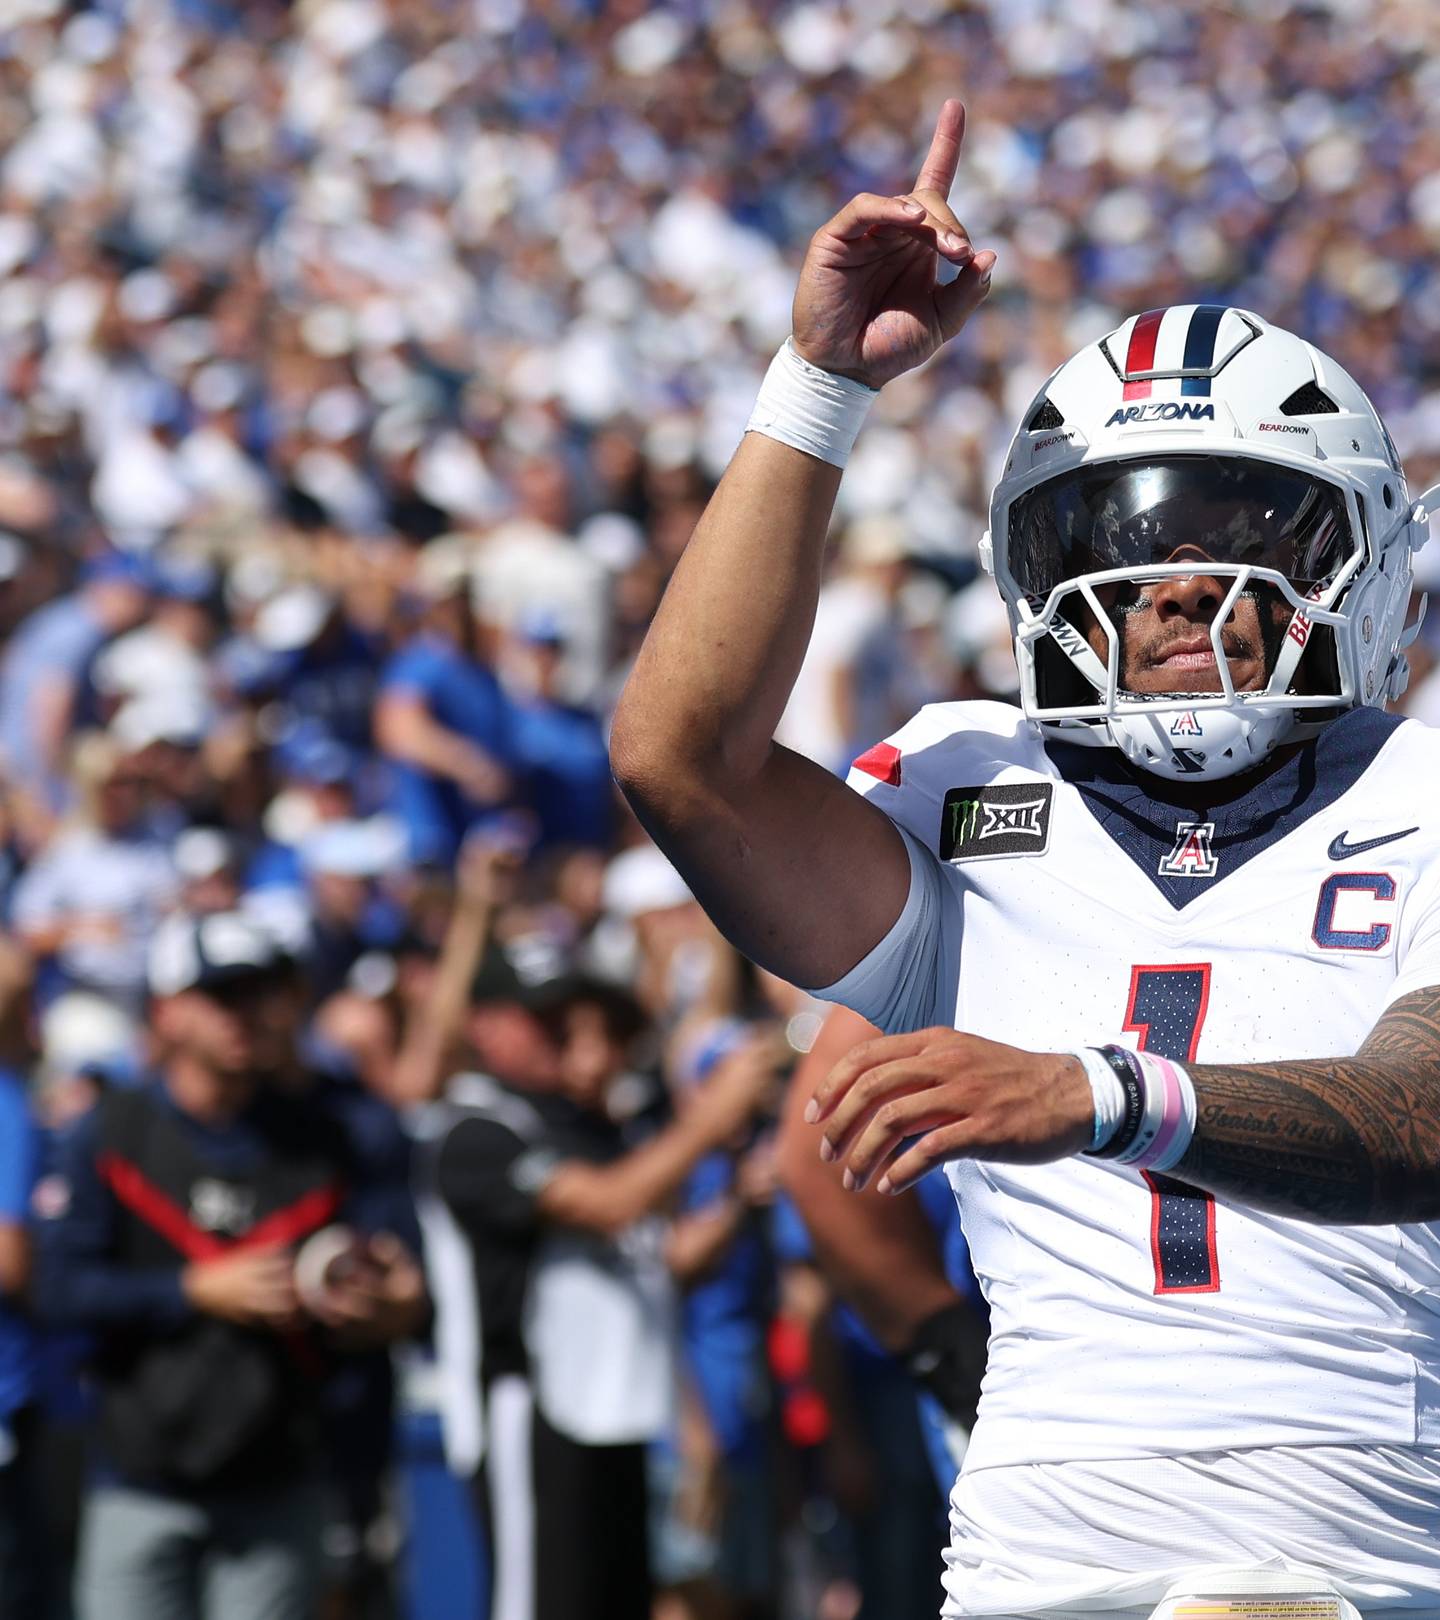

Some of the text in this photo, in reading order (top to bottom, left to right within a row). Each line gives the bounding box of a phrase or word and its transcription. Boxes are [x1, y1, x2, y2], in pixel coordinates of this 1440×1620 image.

[1105, 402, 1215, 428] ARIZONA
[1259, 422, 1310, 436] BEARDOWN
[1158, 821, 1218, 877] A
[1311, 871, 1397, 951] C
[1122, 962, 1221, 1296] 1
